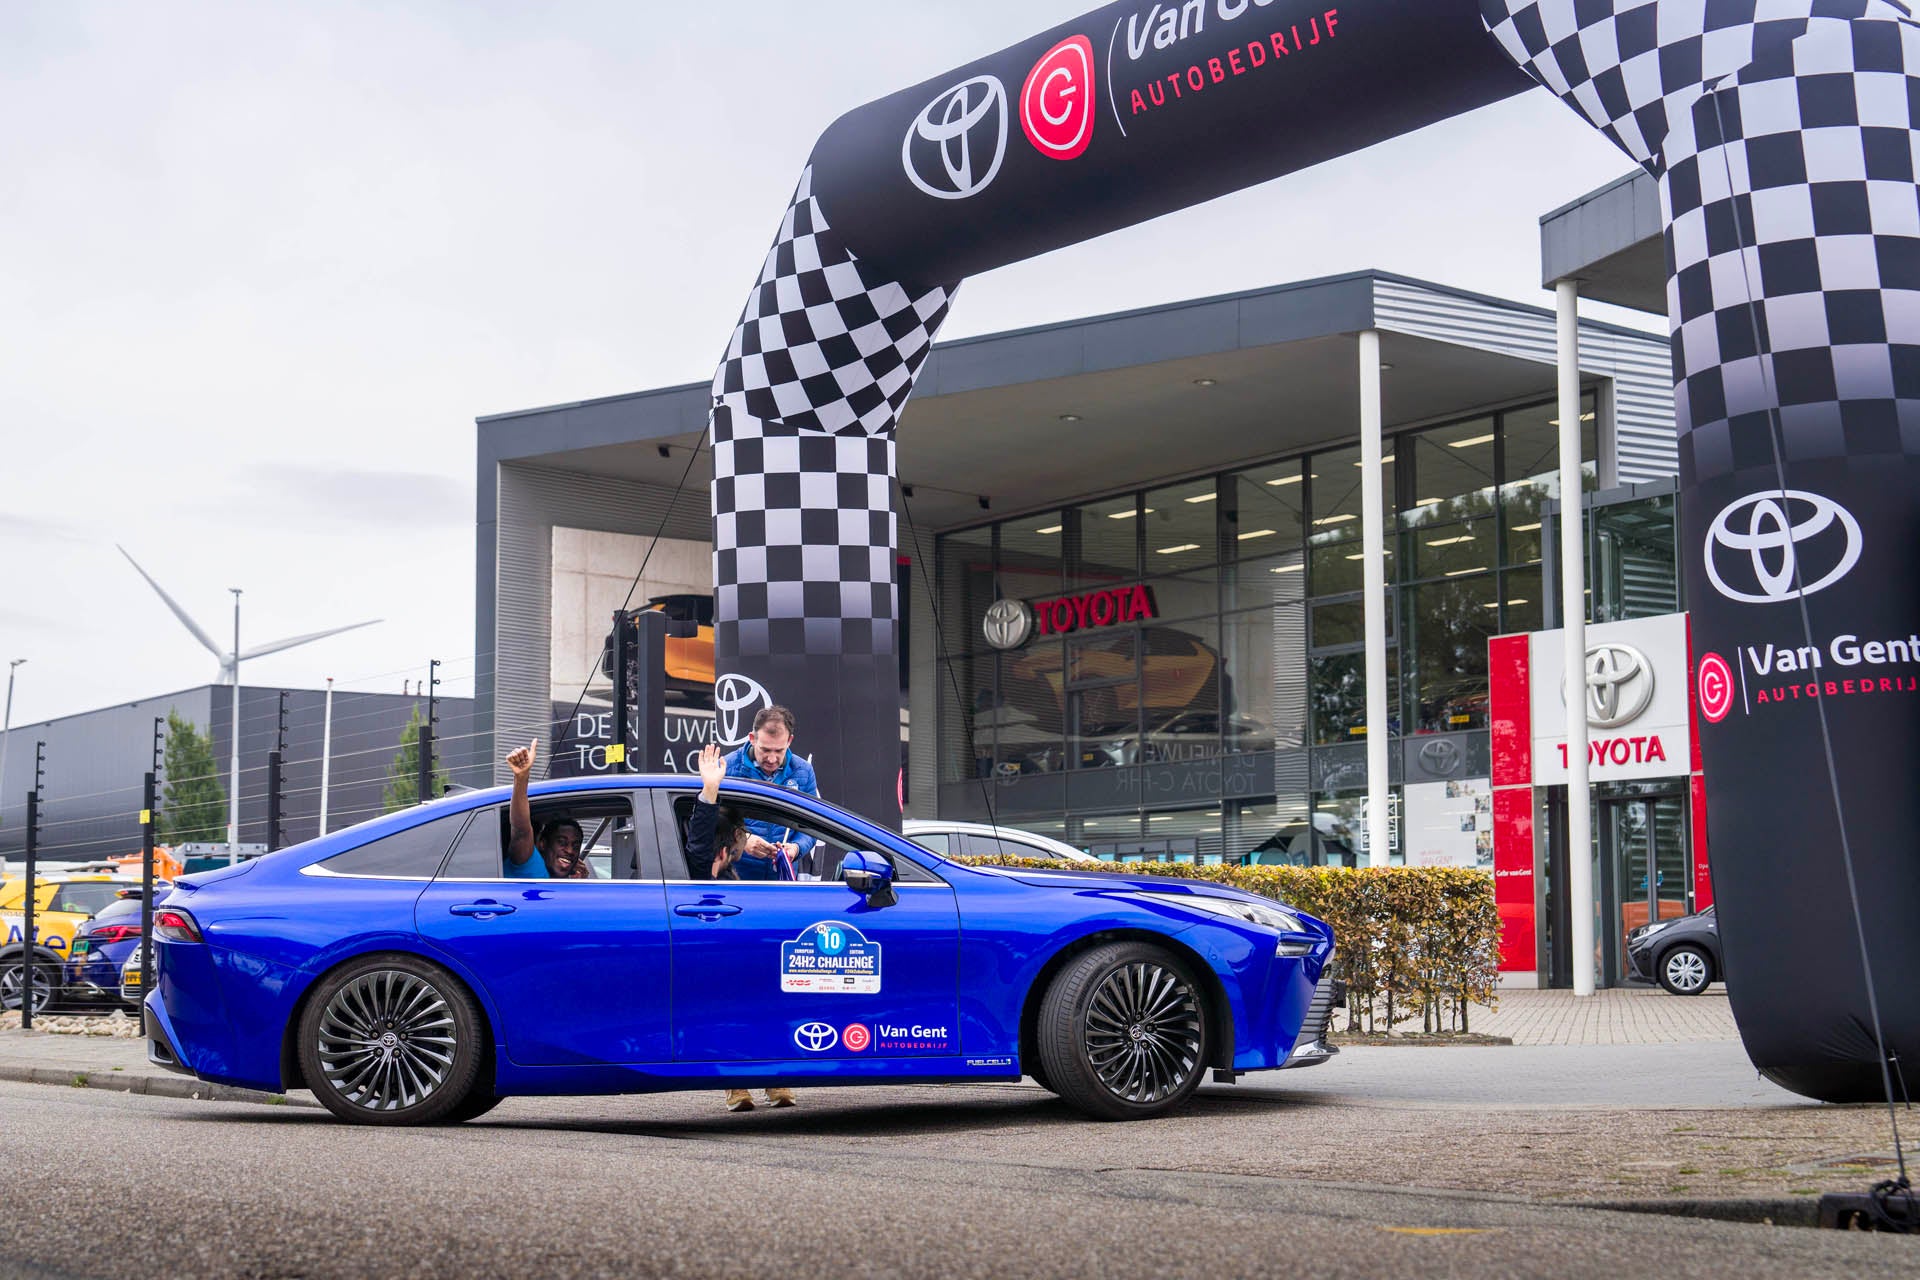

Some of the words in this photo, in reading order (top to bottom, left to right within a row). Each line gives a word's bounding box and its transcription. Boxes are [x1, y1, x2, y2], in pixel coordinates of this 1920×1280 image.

[1127, 0, 1206, 60] Van
[1130, 9, 1339, 115] AUTOBEDRIJF
[1034, 584, 1153, 635] TOYOTA
[1747, 643, 1822, 676] Van
[1830, 634, 1920, 666] Gent
[577, 713, 612, 739] DE
[626, 717, 718, 744] NUWE
[1557, 736, 1666, 769] TYOTA
[822, 932, 840, 949] 10
[789, 954, 816, 968] 24H2
[817, 955, 874, 968] CHALLENGE
[879, 1025, 908, 1038] Van
[911, 1025, 948, 1039] Gent
[880, 1041, 948, 1049] AUTOBEDRIJF
